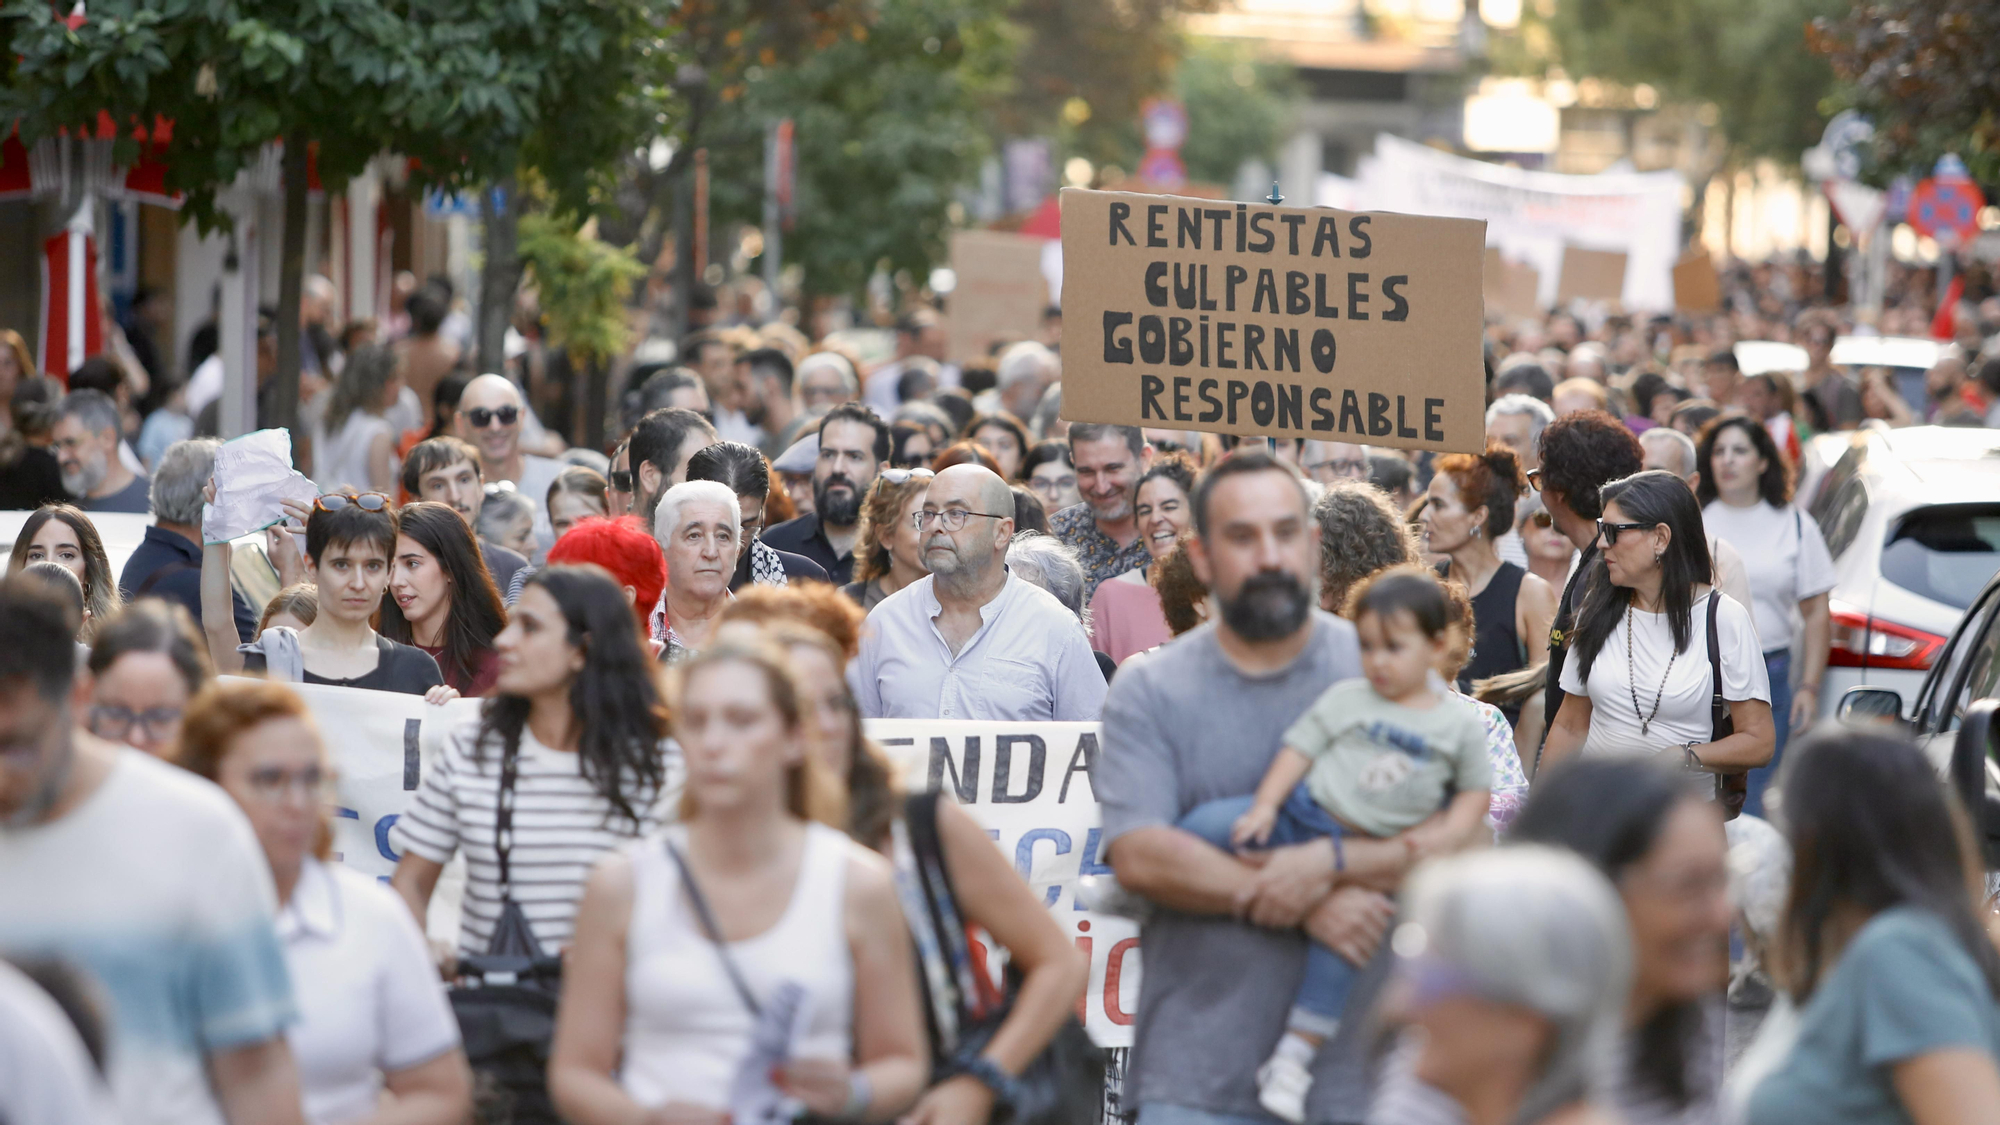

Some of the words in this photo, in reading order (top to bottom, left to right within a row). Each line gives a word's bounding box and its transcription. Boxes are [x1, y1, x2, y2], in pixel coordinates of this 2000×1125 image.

[1109, 202, 1372, 259] RENTISTAS
[1144, 261, 1409, 322] CULPABLES
[1103, 310, 1337, 374] GOBIERNO
[1141, 374, 1445, 442] RESPONSABLE
[876, 732, 1102, 805] NDA
